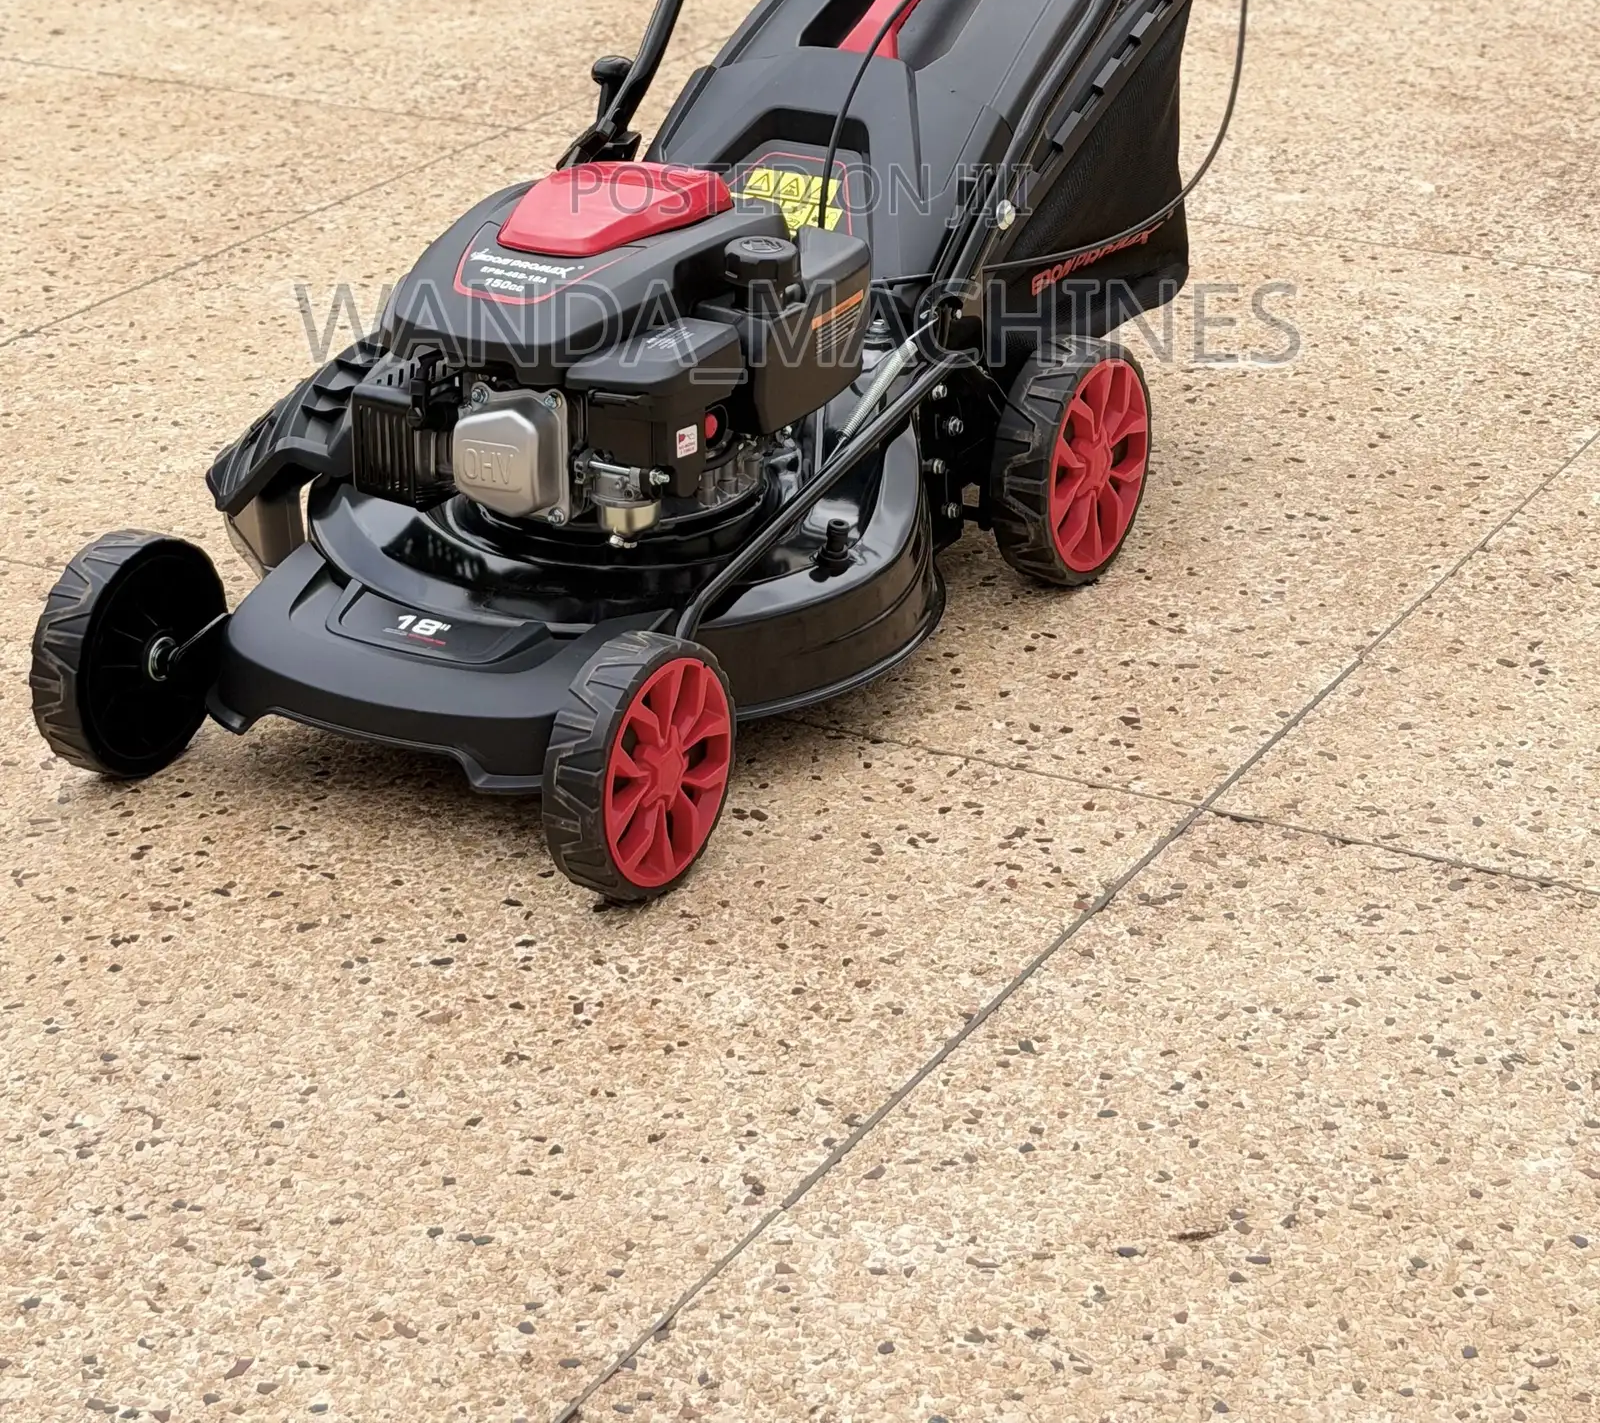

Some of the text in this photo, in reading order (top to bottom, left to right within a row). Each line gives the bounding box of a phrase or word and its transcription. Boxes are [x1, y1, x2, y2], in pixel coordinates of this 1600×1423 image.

[485, 277, 525, 292] 150cc
[463, 448, 514, 485] OHV
[397, 614, 452, 636] 18"
